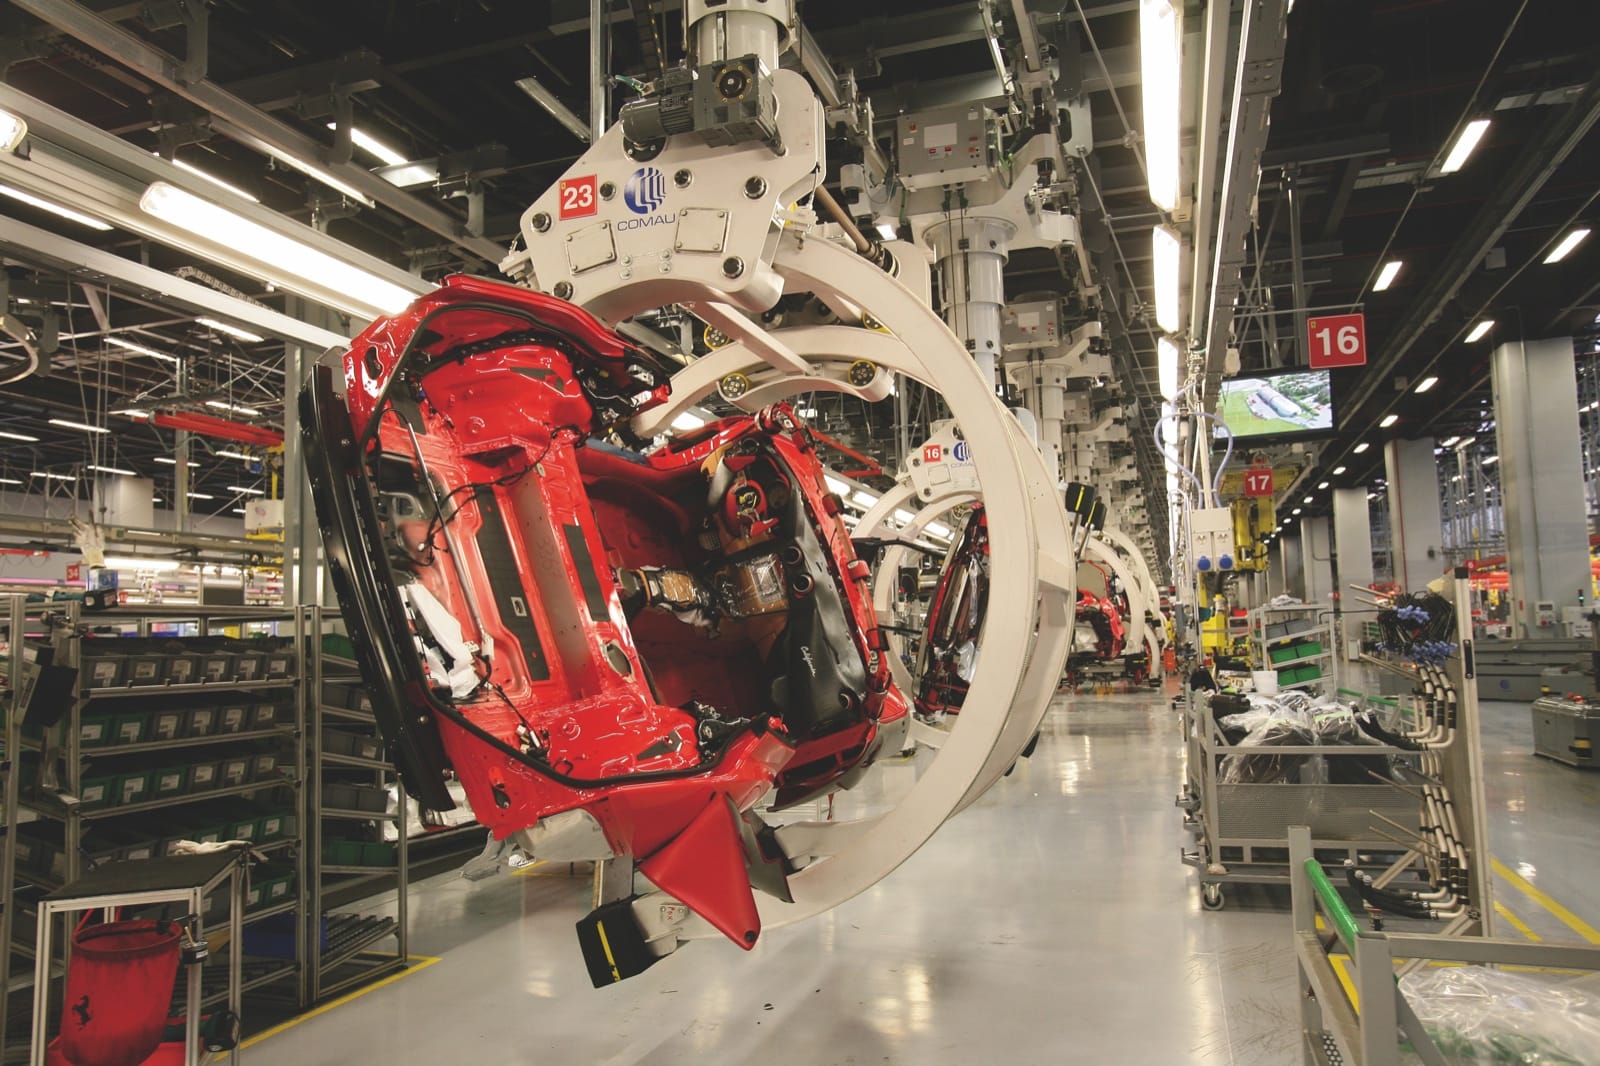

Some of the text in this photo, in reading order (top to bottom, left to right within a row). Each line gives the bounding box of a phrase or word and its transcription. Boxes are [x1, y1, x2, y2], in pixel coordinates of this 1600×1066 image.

[563, 184, 593, 210] 23
[617, 213, 676, 231] COMAU
[1315, 325, 1359, 356] 16
[926, 448, 939, 459] 16
[1248, 475, 1270, 491] 17
[67, 567, 78, 578] 34
